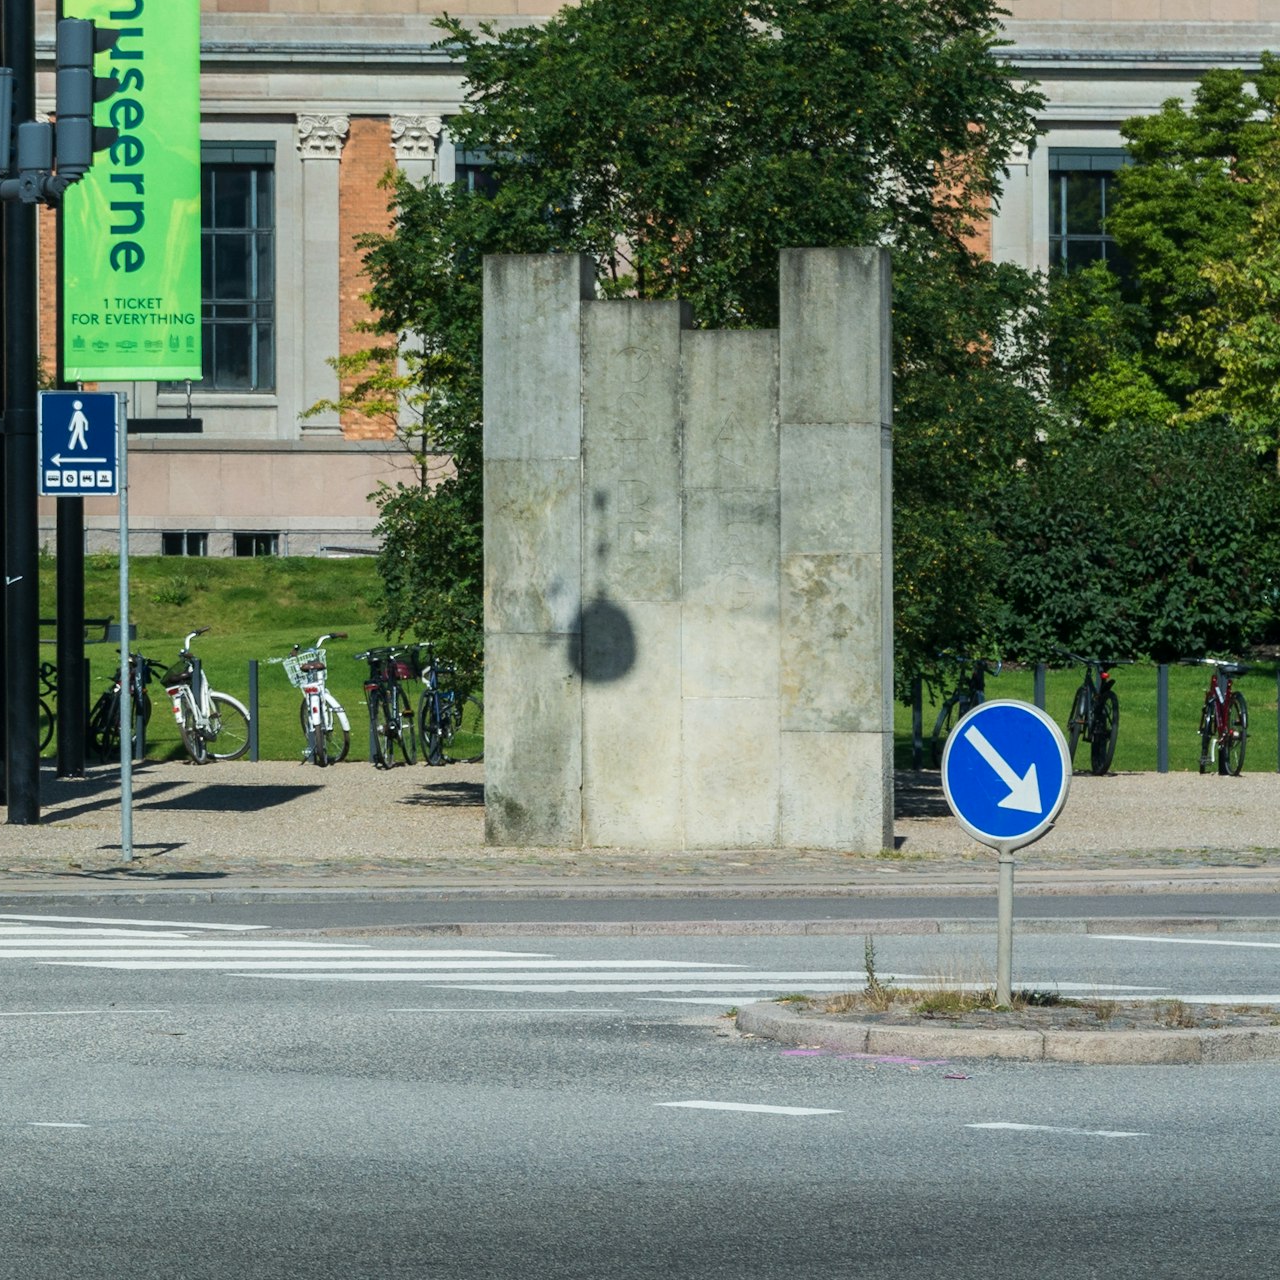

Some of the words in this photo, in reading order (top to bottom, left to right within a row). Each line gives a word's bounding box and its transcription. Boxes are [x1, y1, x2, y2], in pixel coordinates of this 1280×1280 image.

[103, 298, 109, 310] 1
[114, 297, 163, 309] TICKET
[71, 313, 100, 325] FOR
[105, 313, 196, 326] EVERYTHING
